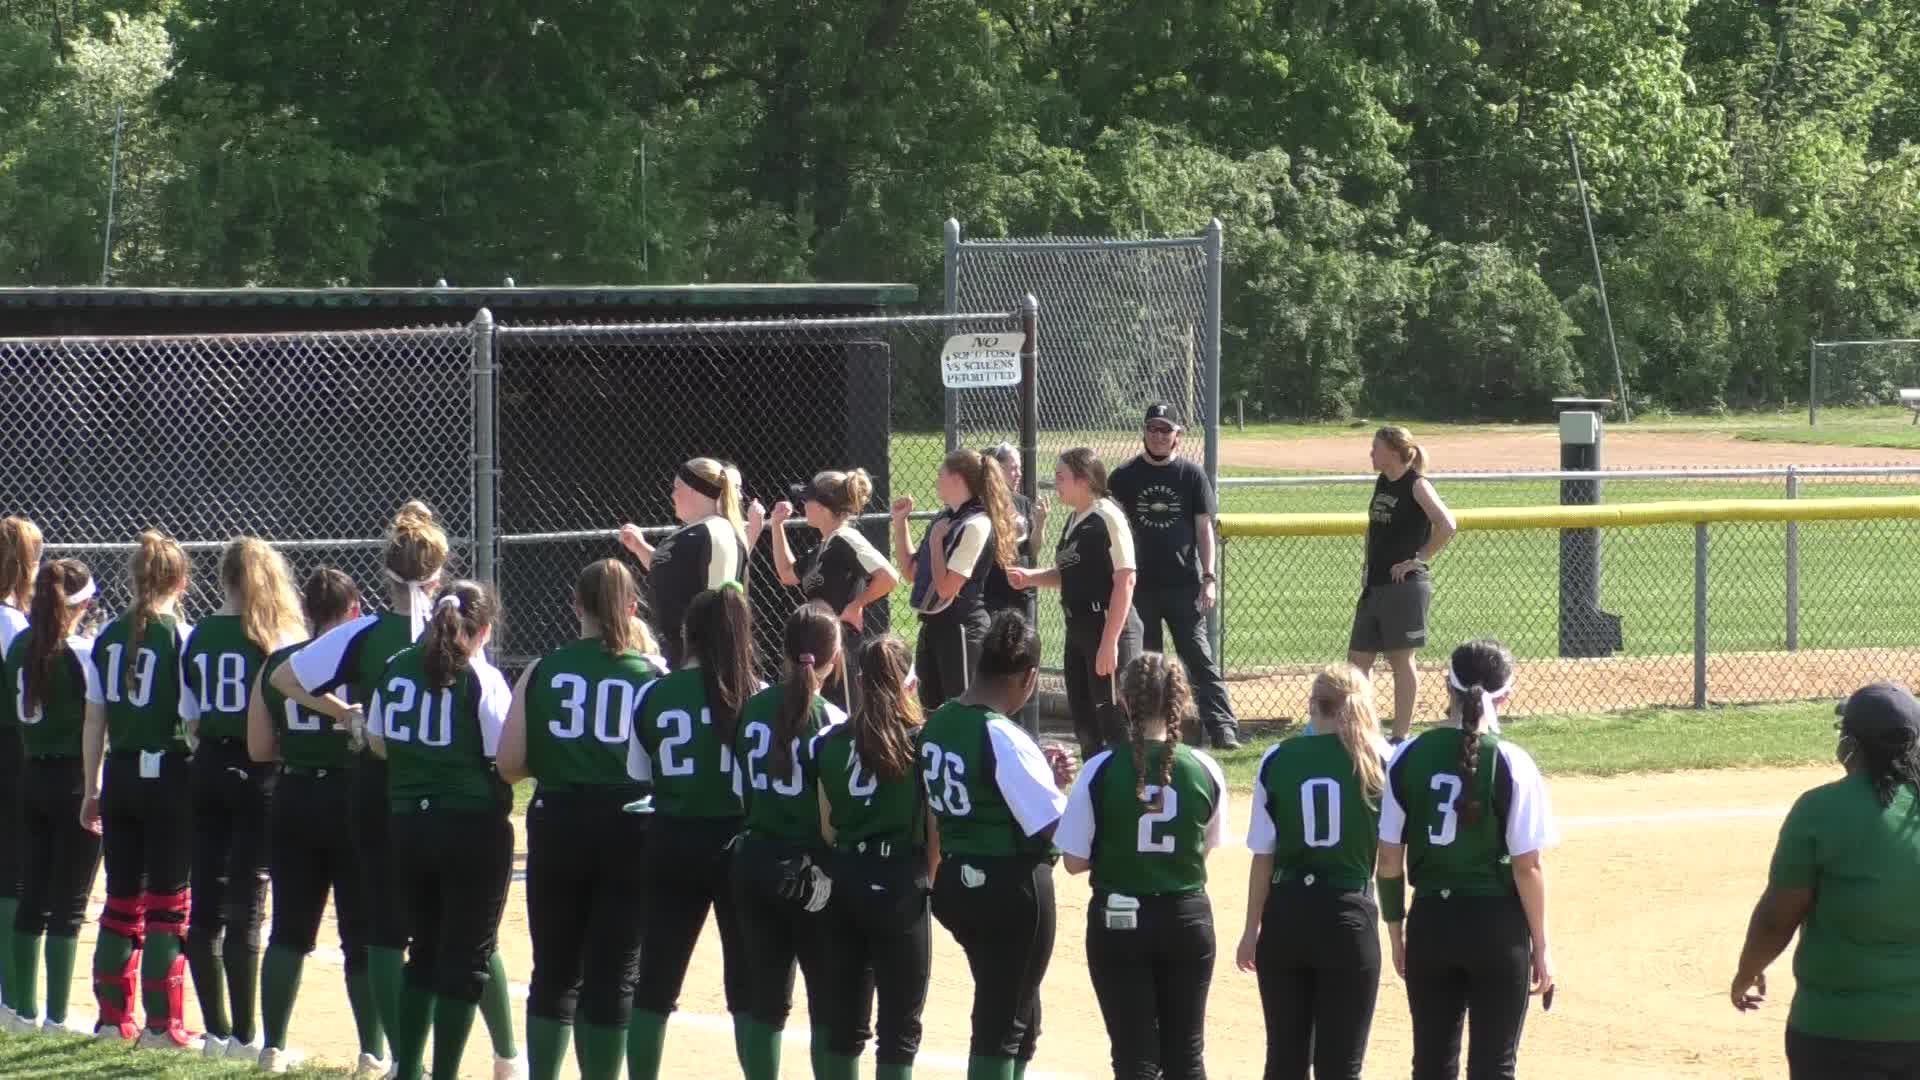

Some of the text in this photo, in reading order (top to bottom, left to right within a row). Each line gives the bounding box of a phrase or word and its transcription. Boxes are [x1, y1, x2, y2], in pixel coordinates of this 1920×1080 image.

[963, 359, 1014, 371] SCREENS
[971, 337, 999, 348] NO
[946, 371, 1017, 384] PERMITTED
[105, 642, 157, 707] 19
[193, 652, 247, 713] 18
[548, 672, 635, 744] 30
[385, 676, 453, 747] 20
[922, 741, 971, 817] 26
[1300, 776, 1341, 848] 0
[1427, 772, 1463, 846] 3
[1137, 784, 1178, 853] 2
